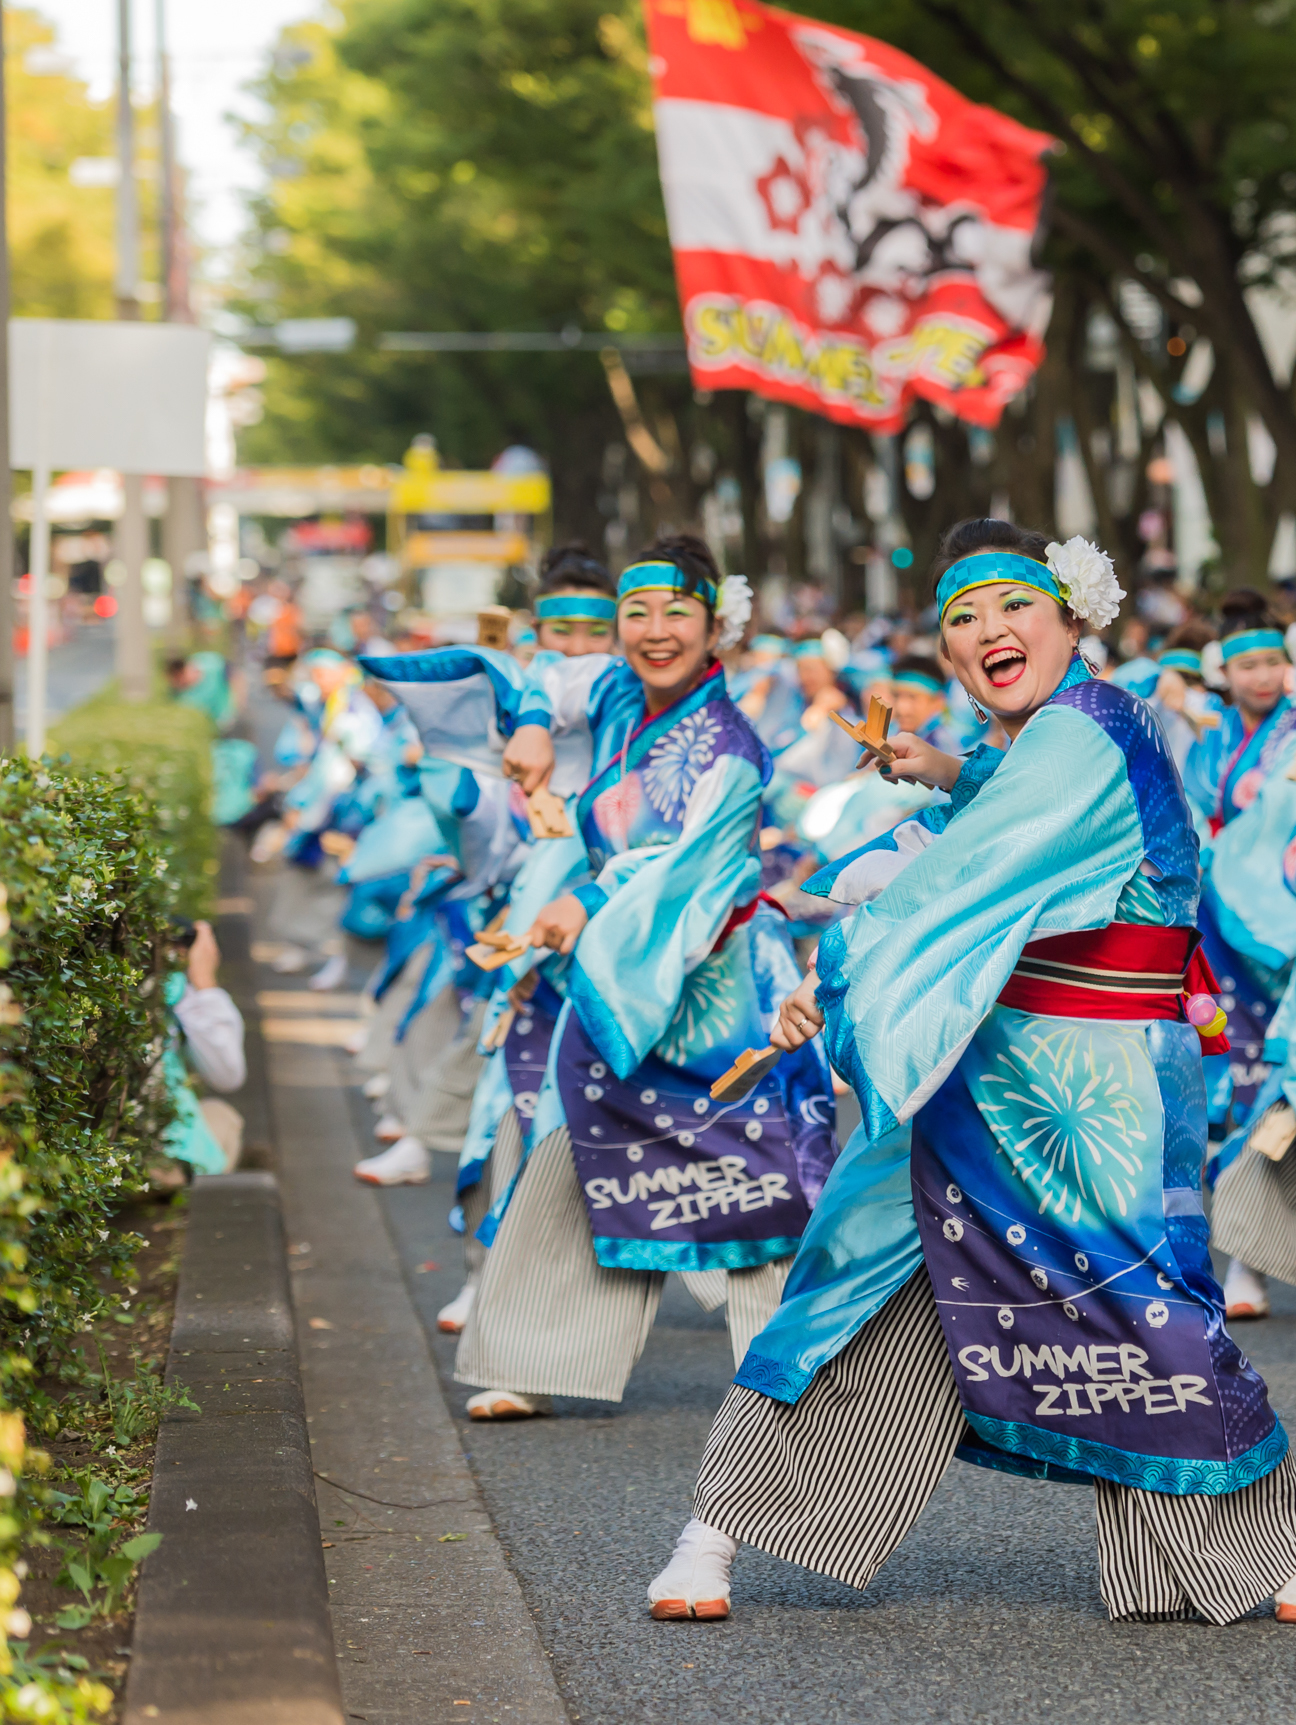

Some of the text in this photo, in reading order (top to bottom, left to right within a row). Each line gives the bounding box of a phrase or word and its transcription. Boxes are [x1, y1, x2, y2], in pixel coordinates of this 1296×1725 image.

[584, 1154, 751, 1210] SUMMER
[647, 1172, 793, 1231] ZIPPER
[957, 1343, 1154, 1382] SUMMER
[1033, 1374, 1214, 1416] ZIPPER
